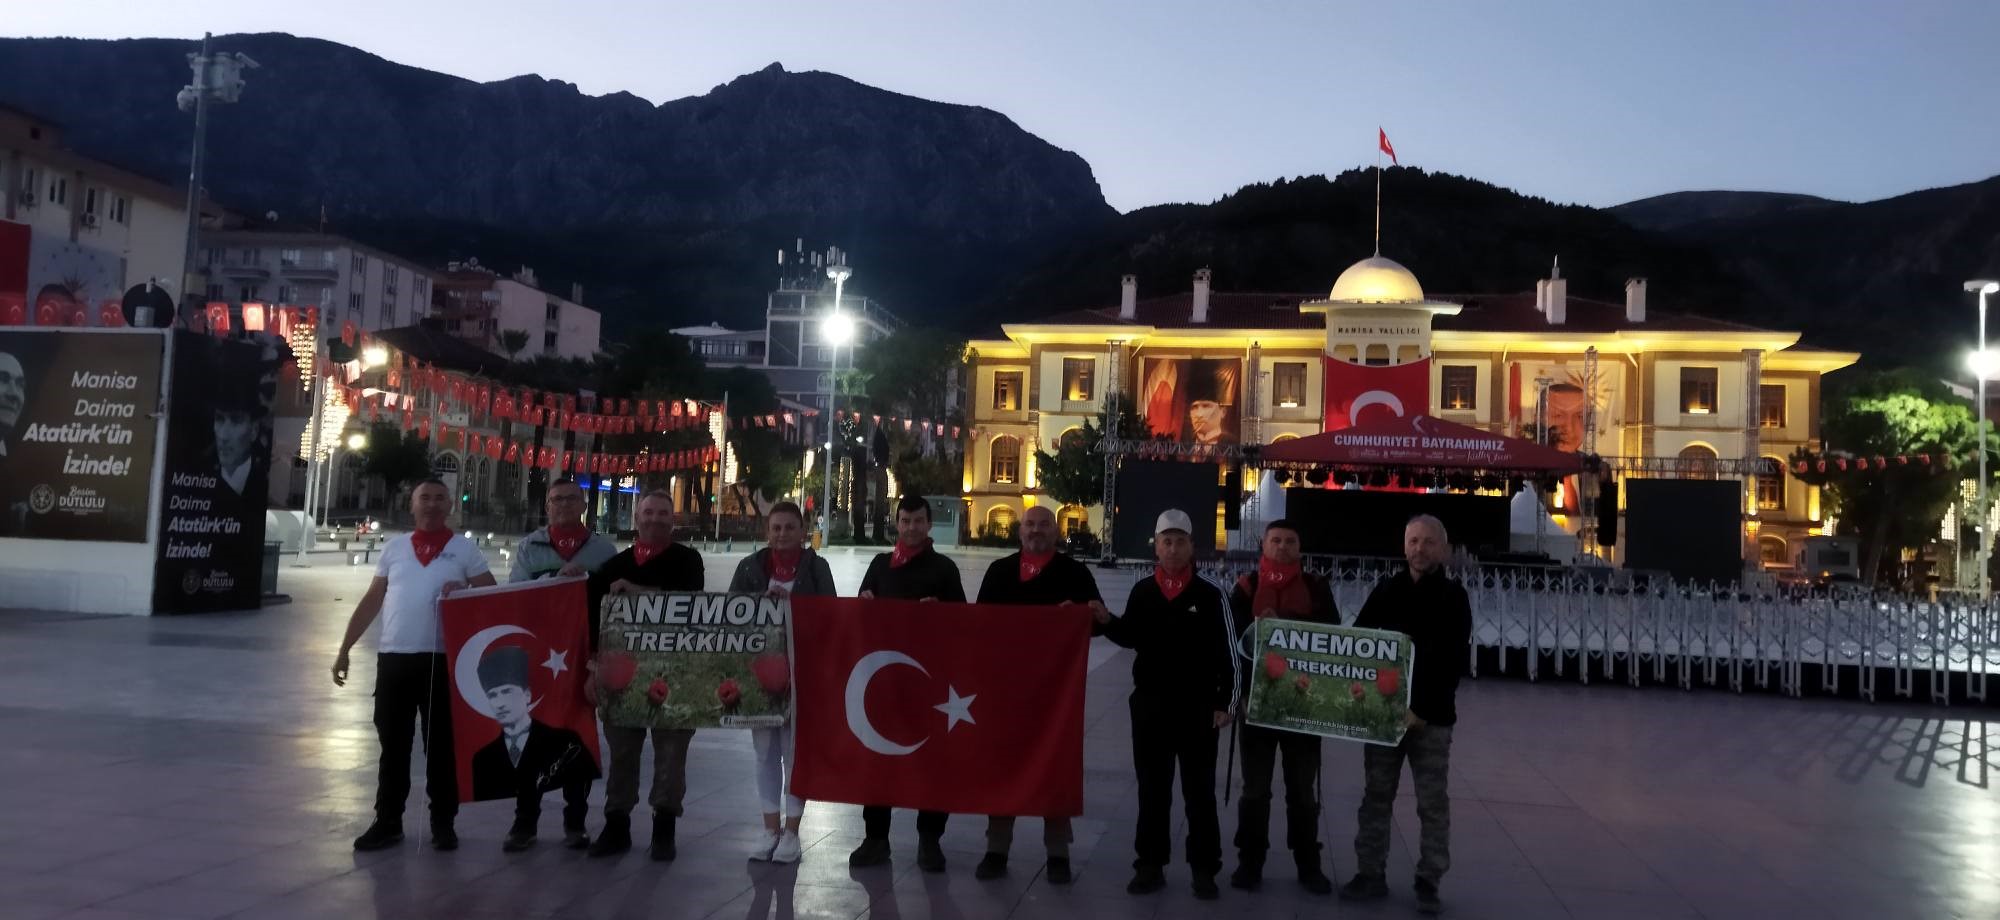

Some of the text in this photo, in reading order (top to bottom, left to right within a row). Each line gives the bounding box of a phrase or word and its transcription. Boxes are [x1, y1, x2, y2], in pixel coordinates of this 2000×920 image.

[71, 370, 138, 389] Manisa
[74, 398, 135, 418] Daima
[22, 422, 132, 445] Atatürk'ün
[1421, 437, 1504, 450] BAYRAMIMIZ
[63, 449, 132, 476] İzinde!
[171, 472, 217, 488] Manisa
[59, 496, 106, 509] DUTLULU
[169, 495, 212, 511] Daima
[167, 516, 241, 534] Atatürk'ün
[166, 537, 212, 558] İzinde!
[607, 594, 786, 625] ANEMON
[1269, 628, 1398, 661] ANEMON
